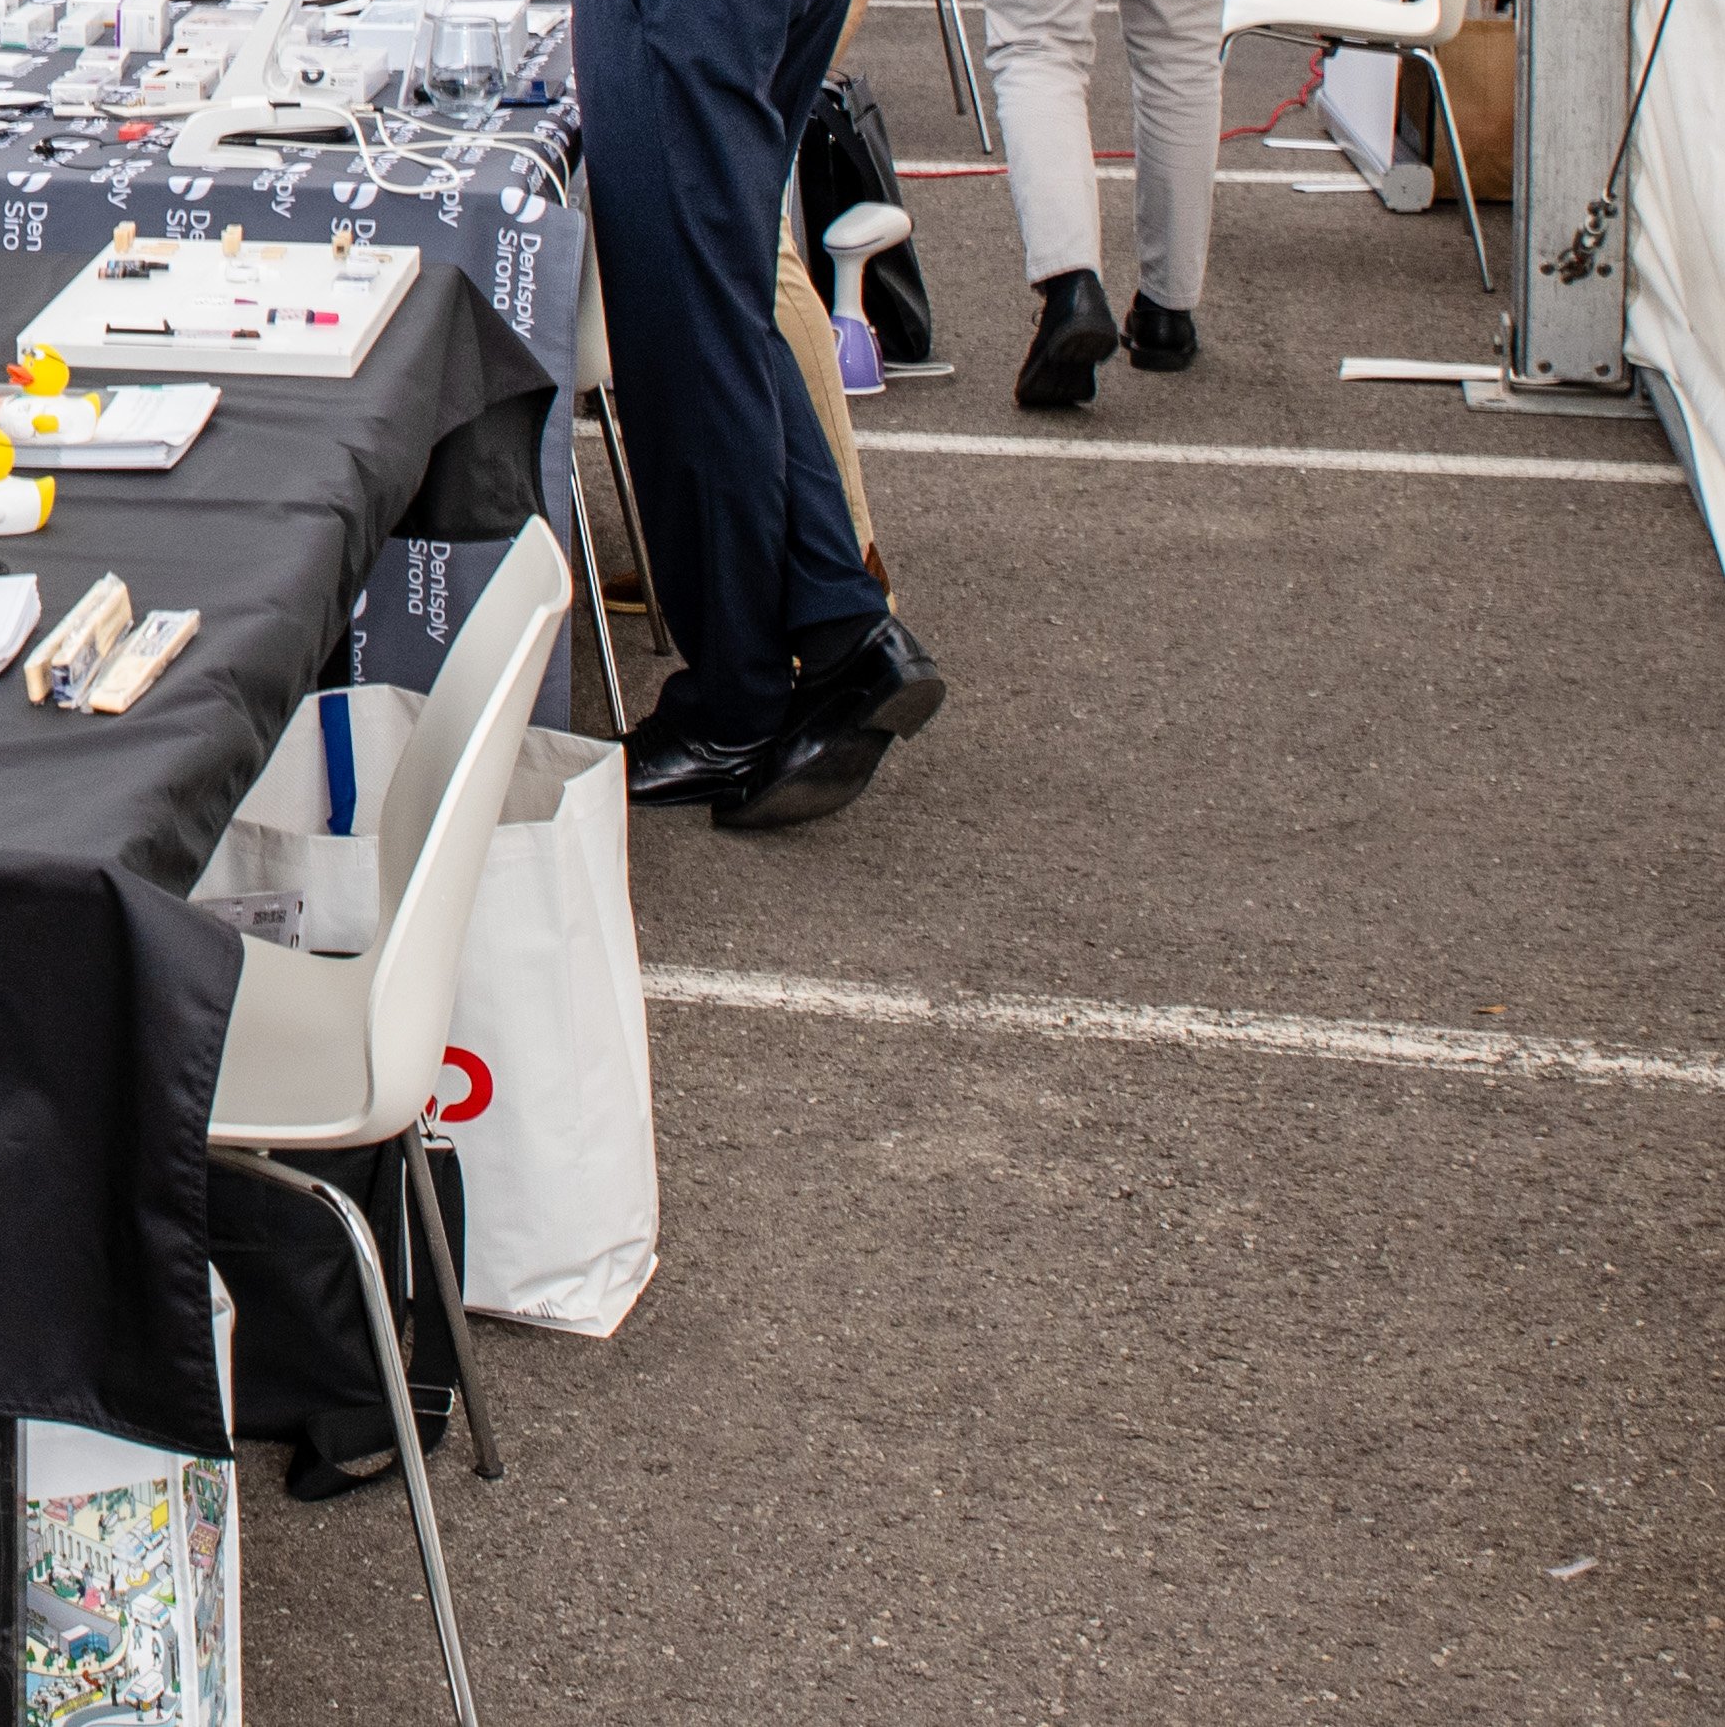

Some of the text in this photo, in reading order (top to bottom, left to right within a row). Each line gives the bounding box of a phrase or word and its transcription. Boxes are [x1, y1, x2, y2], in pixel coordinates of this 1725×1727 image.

[3, 199, 25, 251] Siro
[493, 227, 518, 310] Sirona
[512, 232, 542, 339] Dentsply
[408, 538, 428, 616] Sirona
[426, 541, 451, 645] Dentsply
